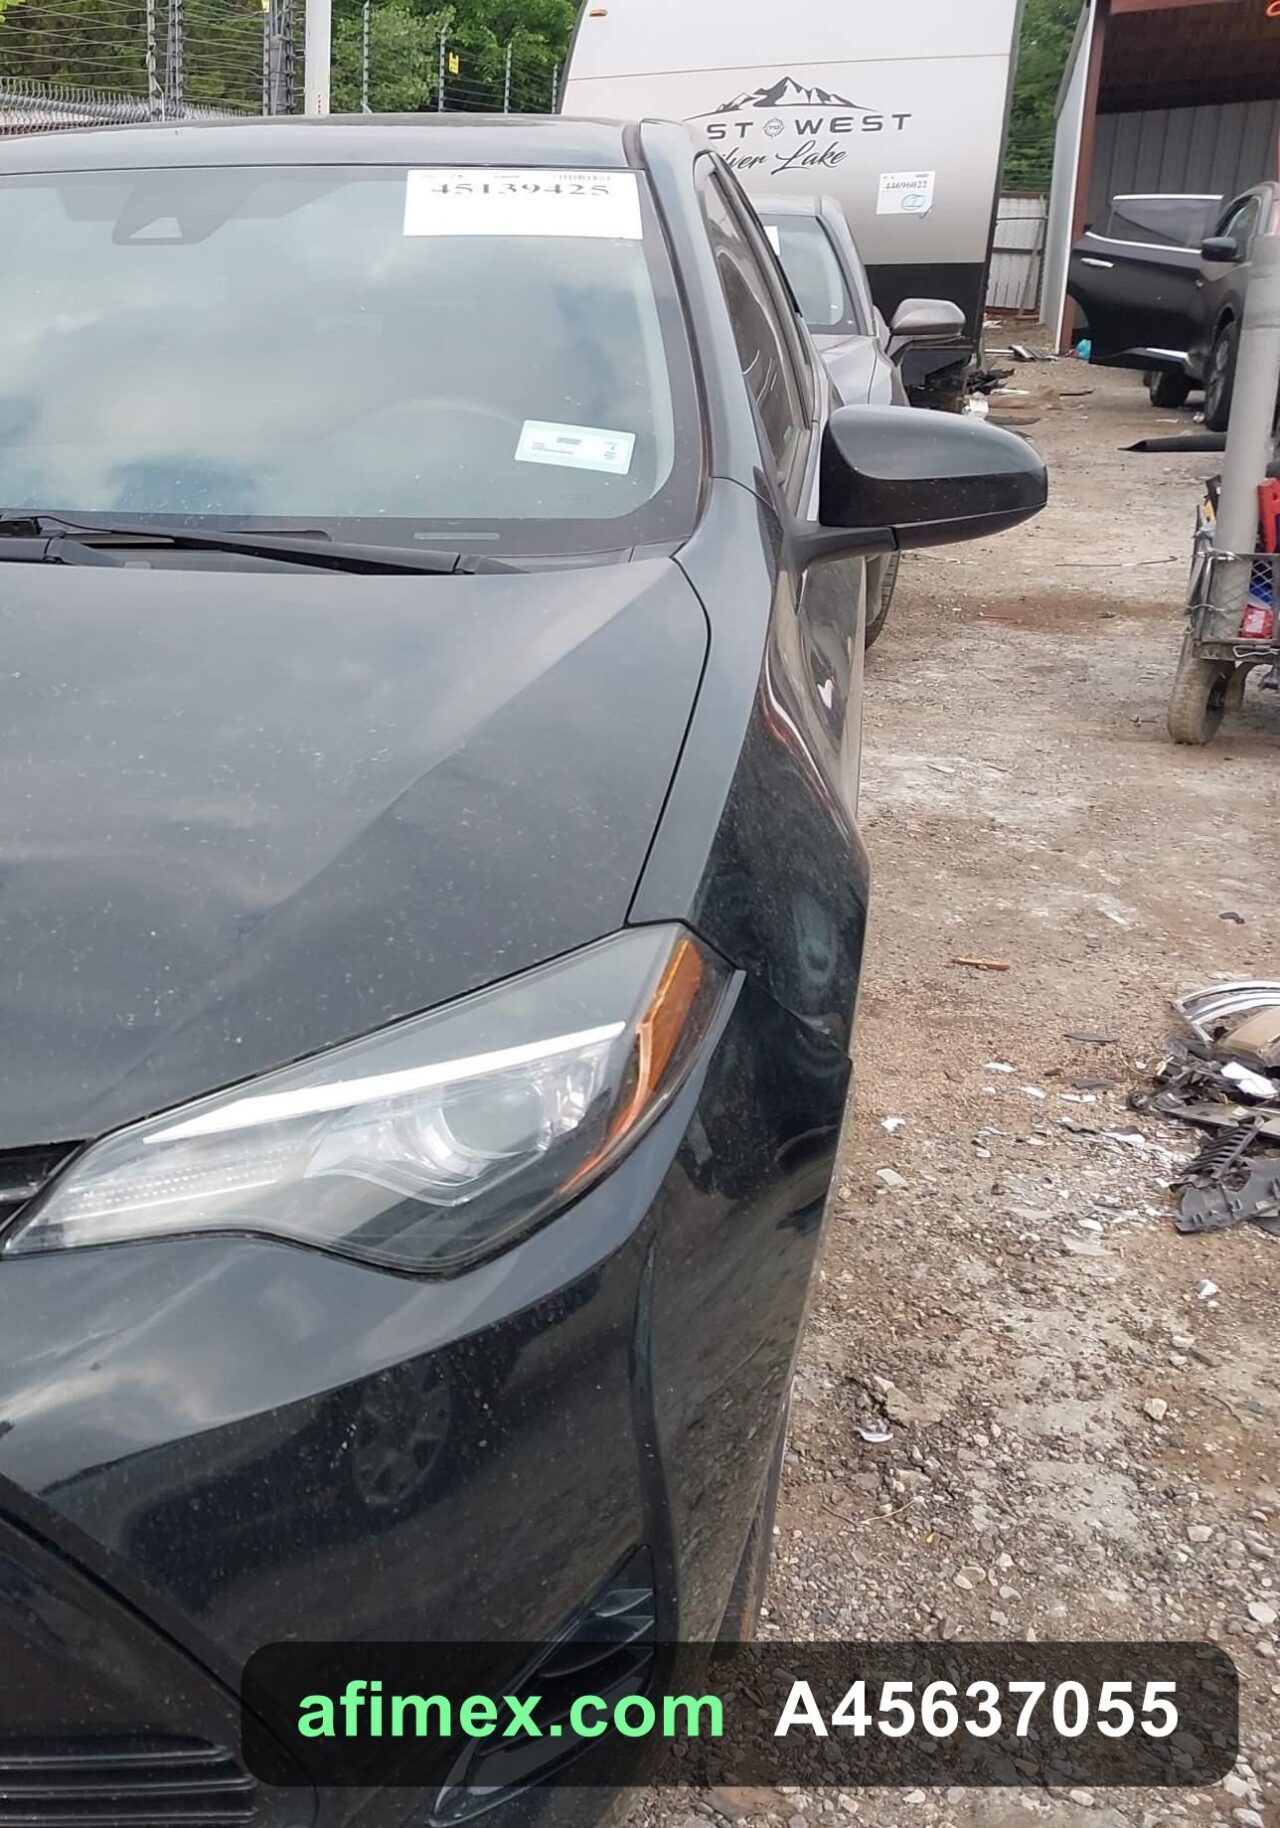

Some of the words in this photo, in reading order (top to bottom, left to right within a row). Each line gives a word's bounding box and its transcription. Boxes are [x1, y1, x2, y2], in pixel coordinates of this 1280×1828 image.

[706, 121, 754, 140] ST
[794, 114, 912, 136] WEST
[770, 140, 848, 175] Lake
[431, 183, 610, 196] 45139425
